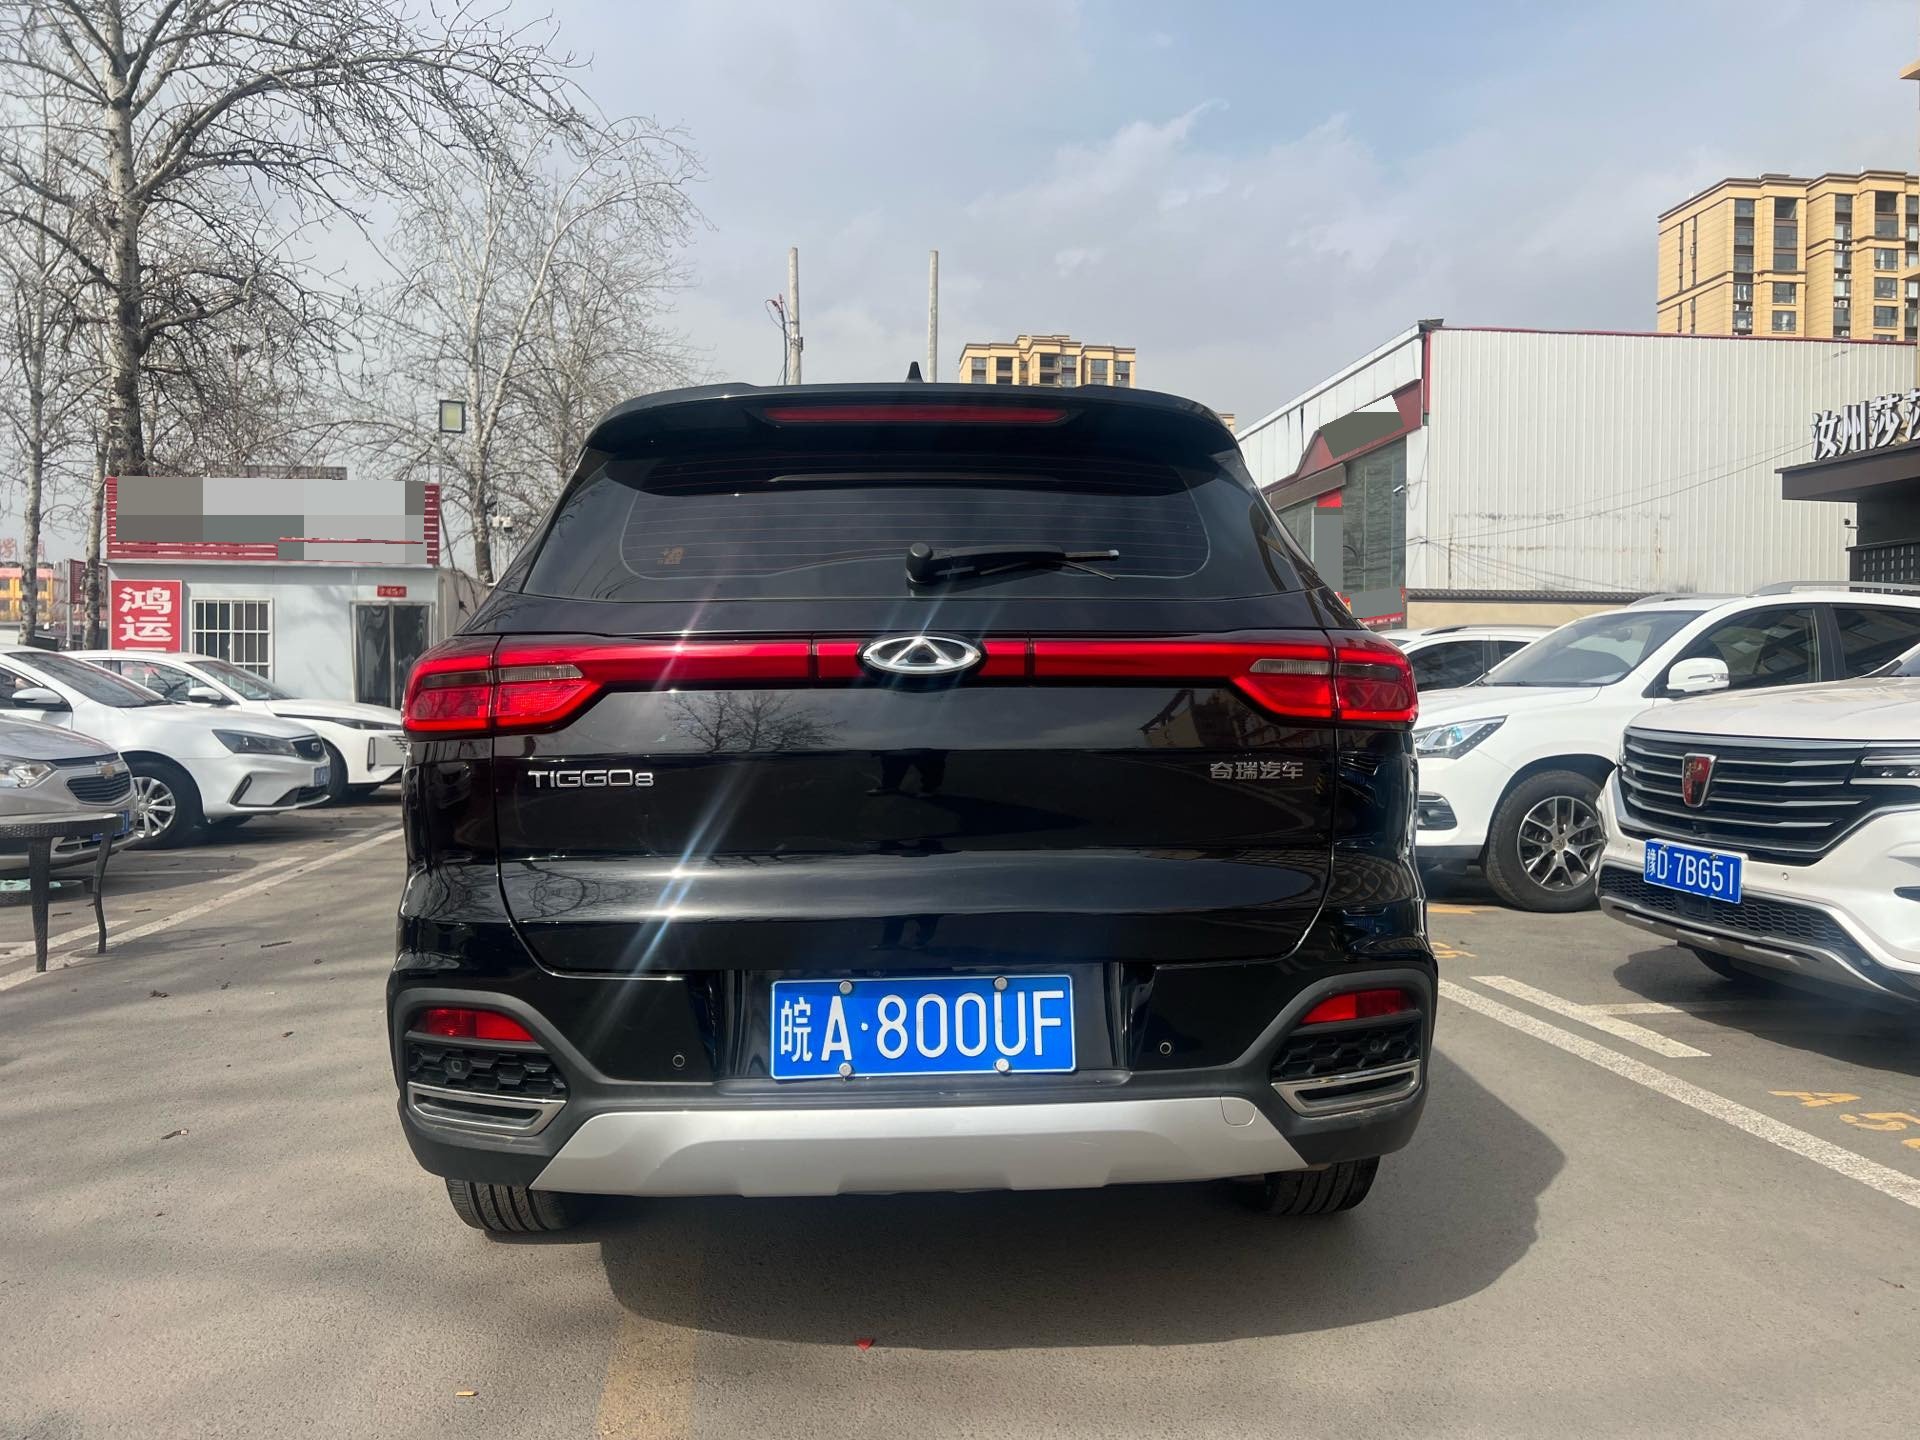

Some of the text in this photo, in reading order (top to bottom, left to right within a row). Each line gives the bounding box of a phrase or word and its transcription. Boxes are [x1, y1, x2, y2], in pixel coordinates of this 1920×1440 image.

[119, 586, 173, 652] 鸿运
[1209, 761, 1303, 780] 奇瑞汽车
